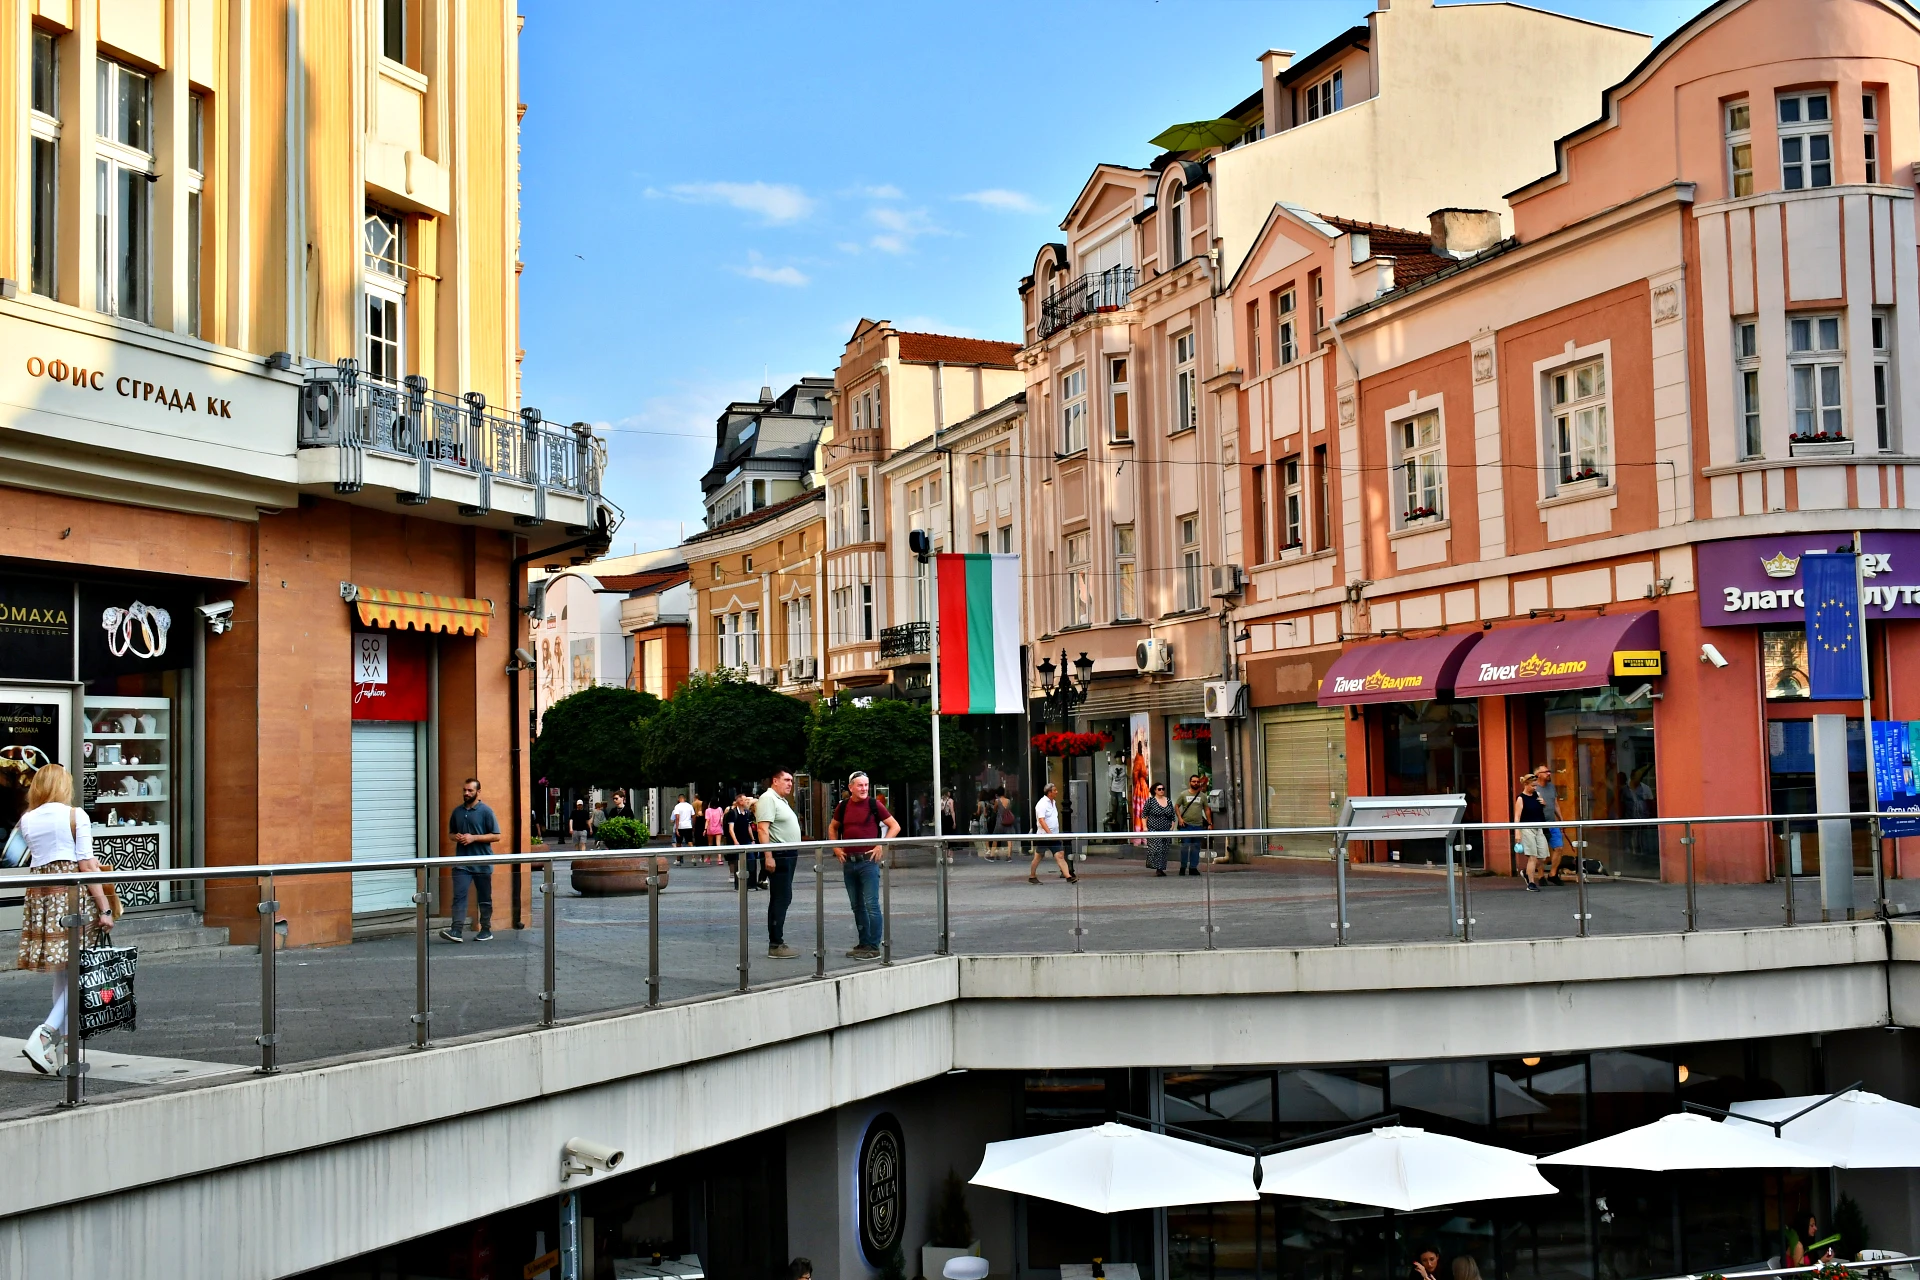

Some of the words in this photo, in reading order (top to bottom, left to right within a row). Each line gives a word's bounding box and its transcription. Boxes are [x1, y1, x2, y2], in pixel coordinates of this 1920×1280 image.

[26, 356, 104, 391] ОФИС
[116, 376, 197, 413] СГРАДА
[1477, 663, 1519, 682] Tavex
[1540, 660, 1587, 676] Злато
[354, 680, 387, 704] Fashion
[1333, 676, 1365, 693] Tavex
[1381, 675, 1423, 690] Валута
[869, 1179, 897, 1204] CAVEA
